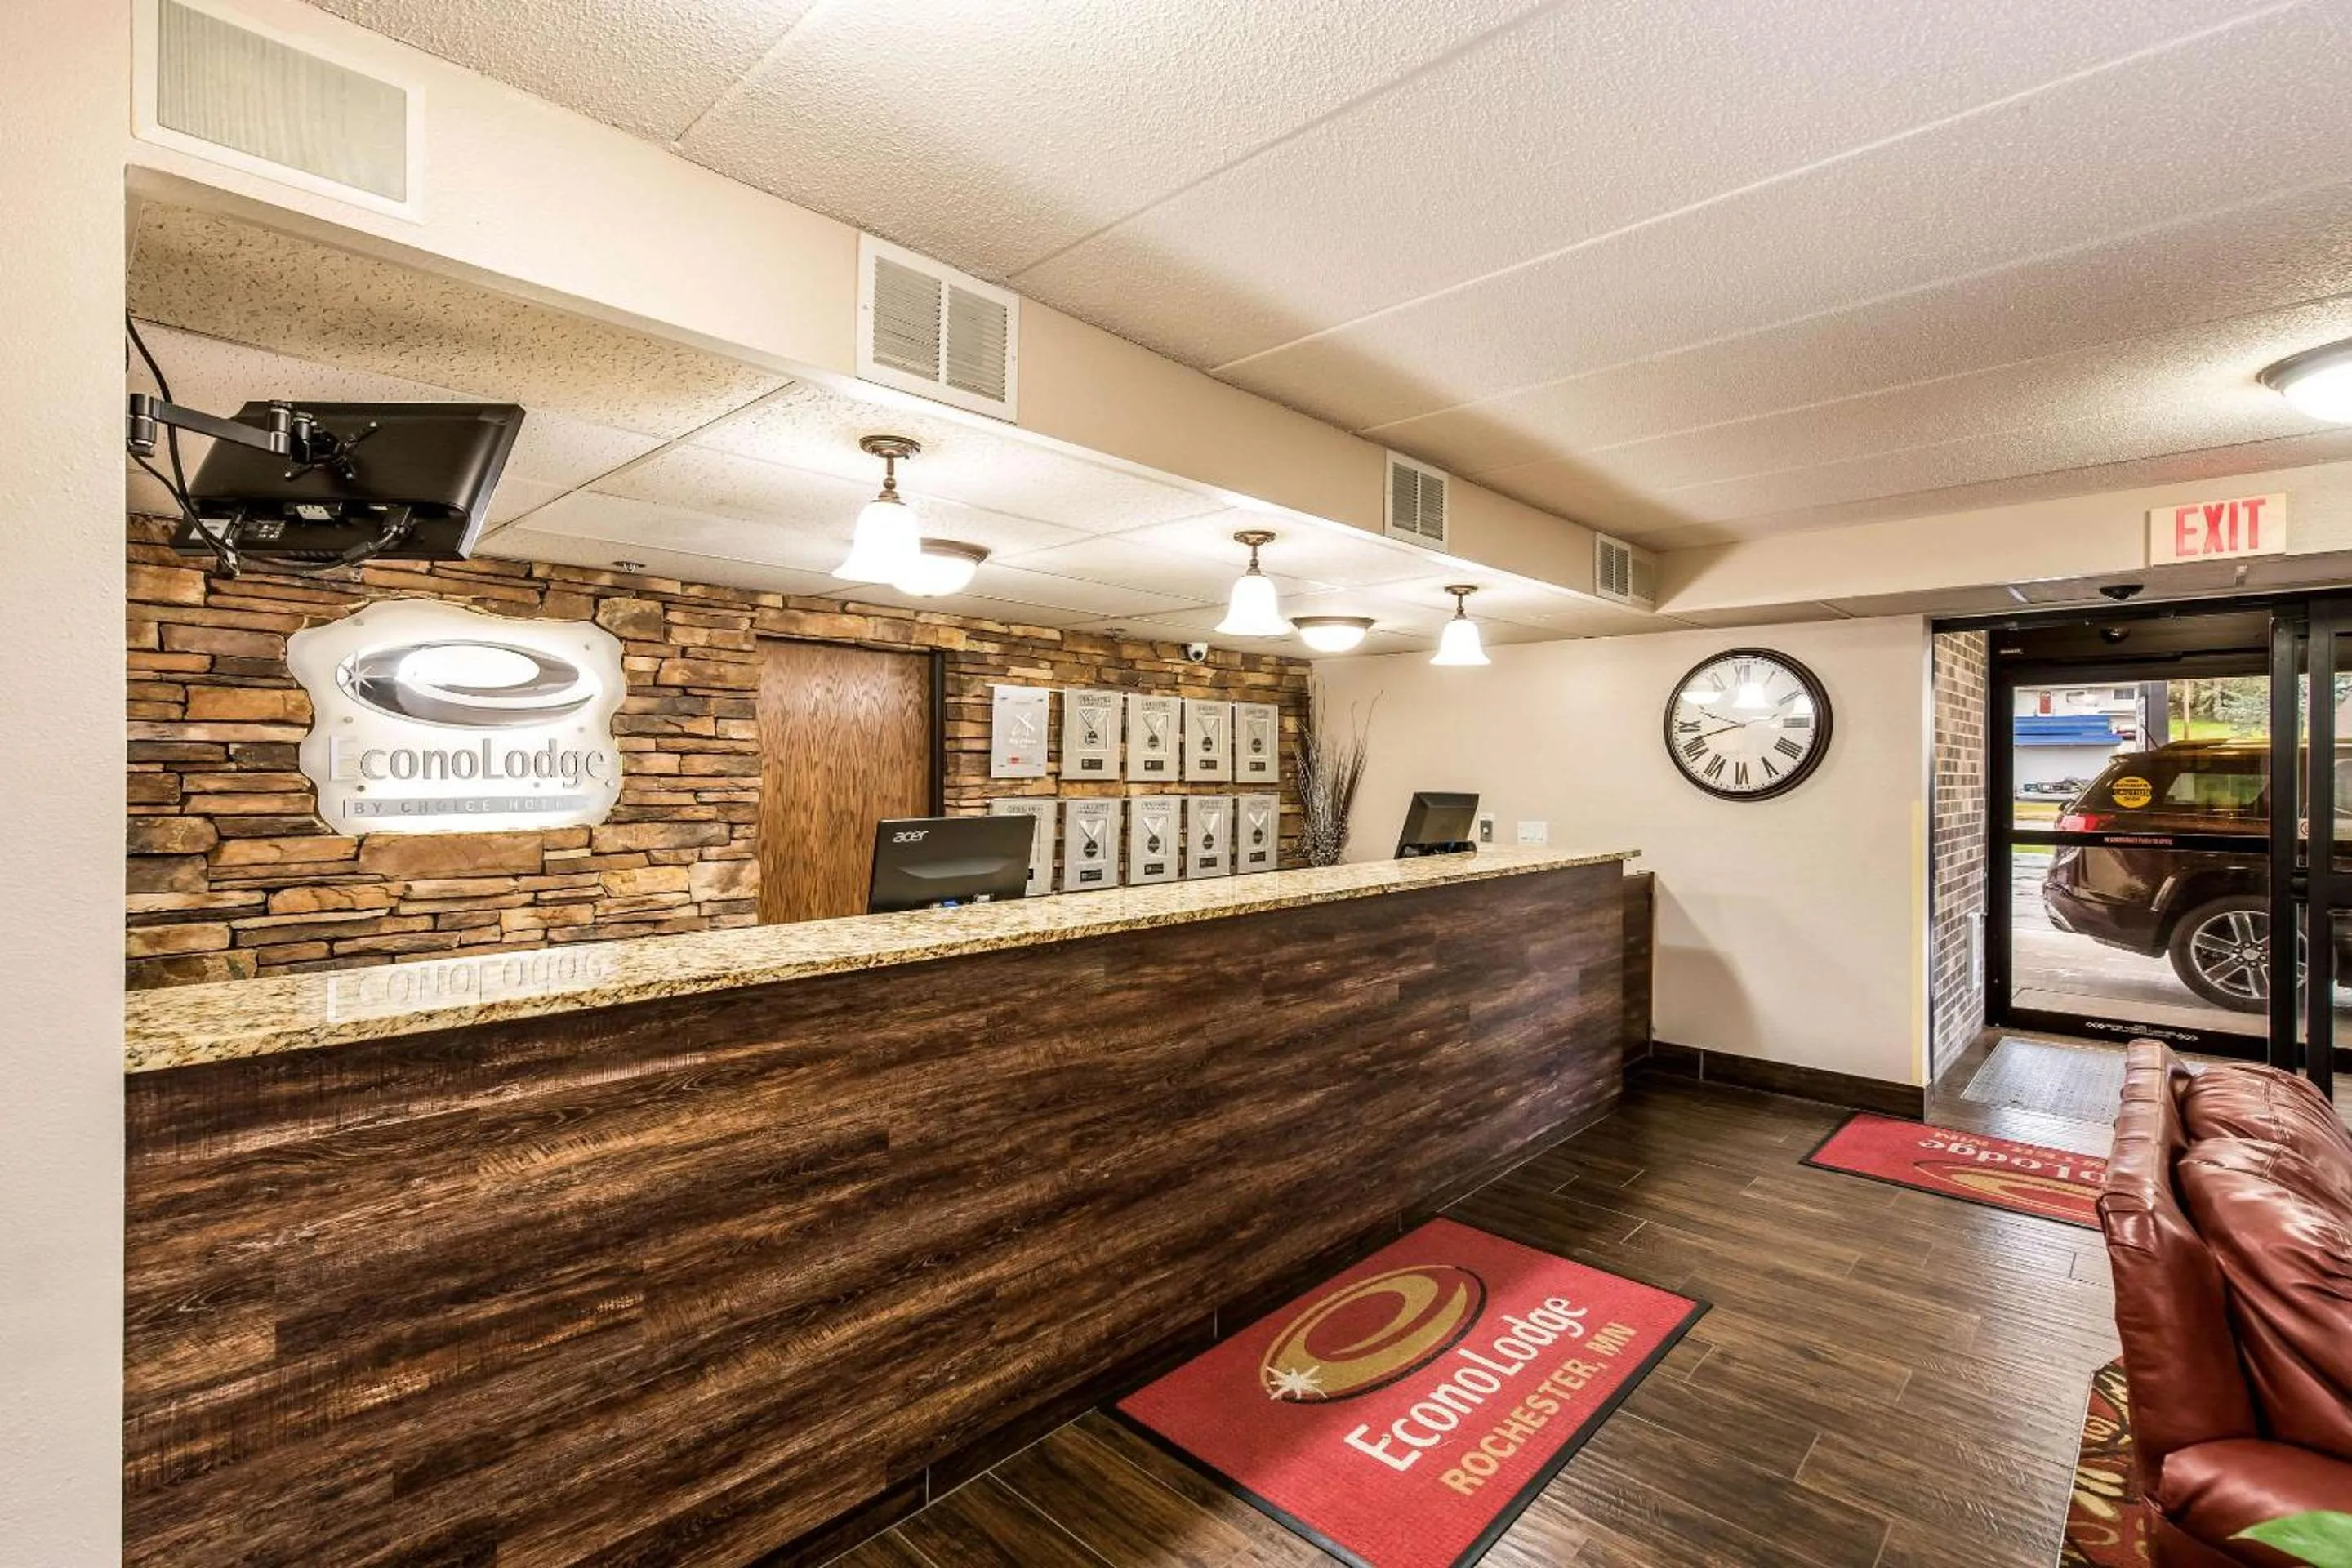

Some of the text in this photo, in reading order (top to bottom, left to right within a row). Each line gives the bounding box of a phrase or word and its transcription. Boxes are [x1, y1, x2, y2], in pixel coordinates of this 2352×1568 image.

[2176, 497, 2266, 557] EXIT
[328, 735, 605, 789] EconoLodge
[354, 797, 588, 815] BY CHOICE HOT
[892, 829, 929, 844] acer
[1343, 1297, 1588, 1472] EconoLodge
[1439, 1321, 1638, 1496] ROCHESTER, MN
